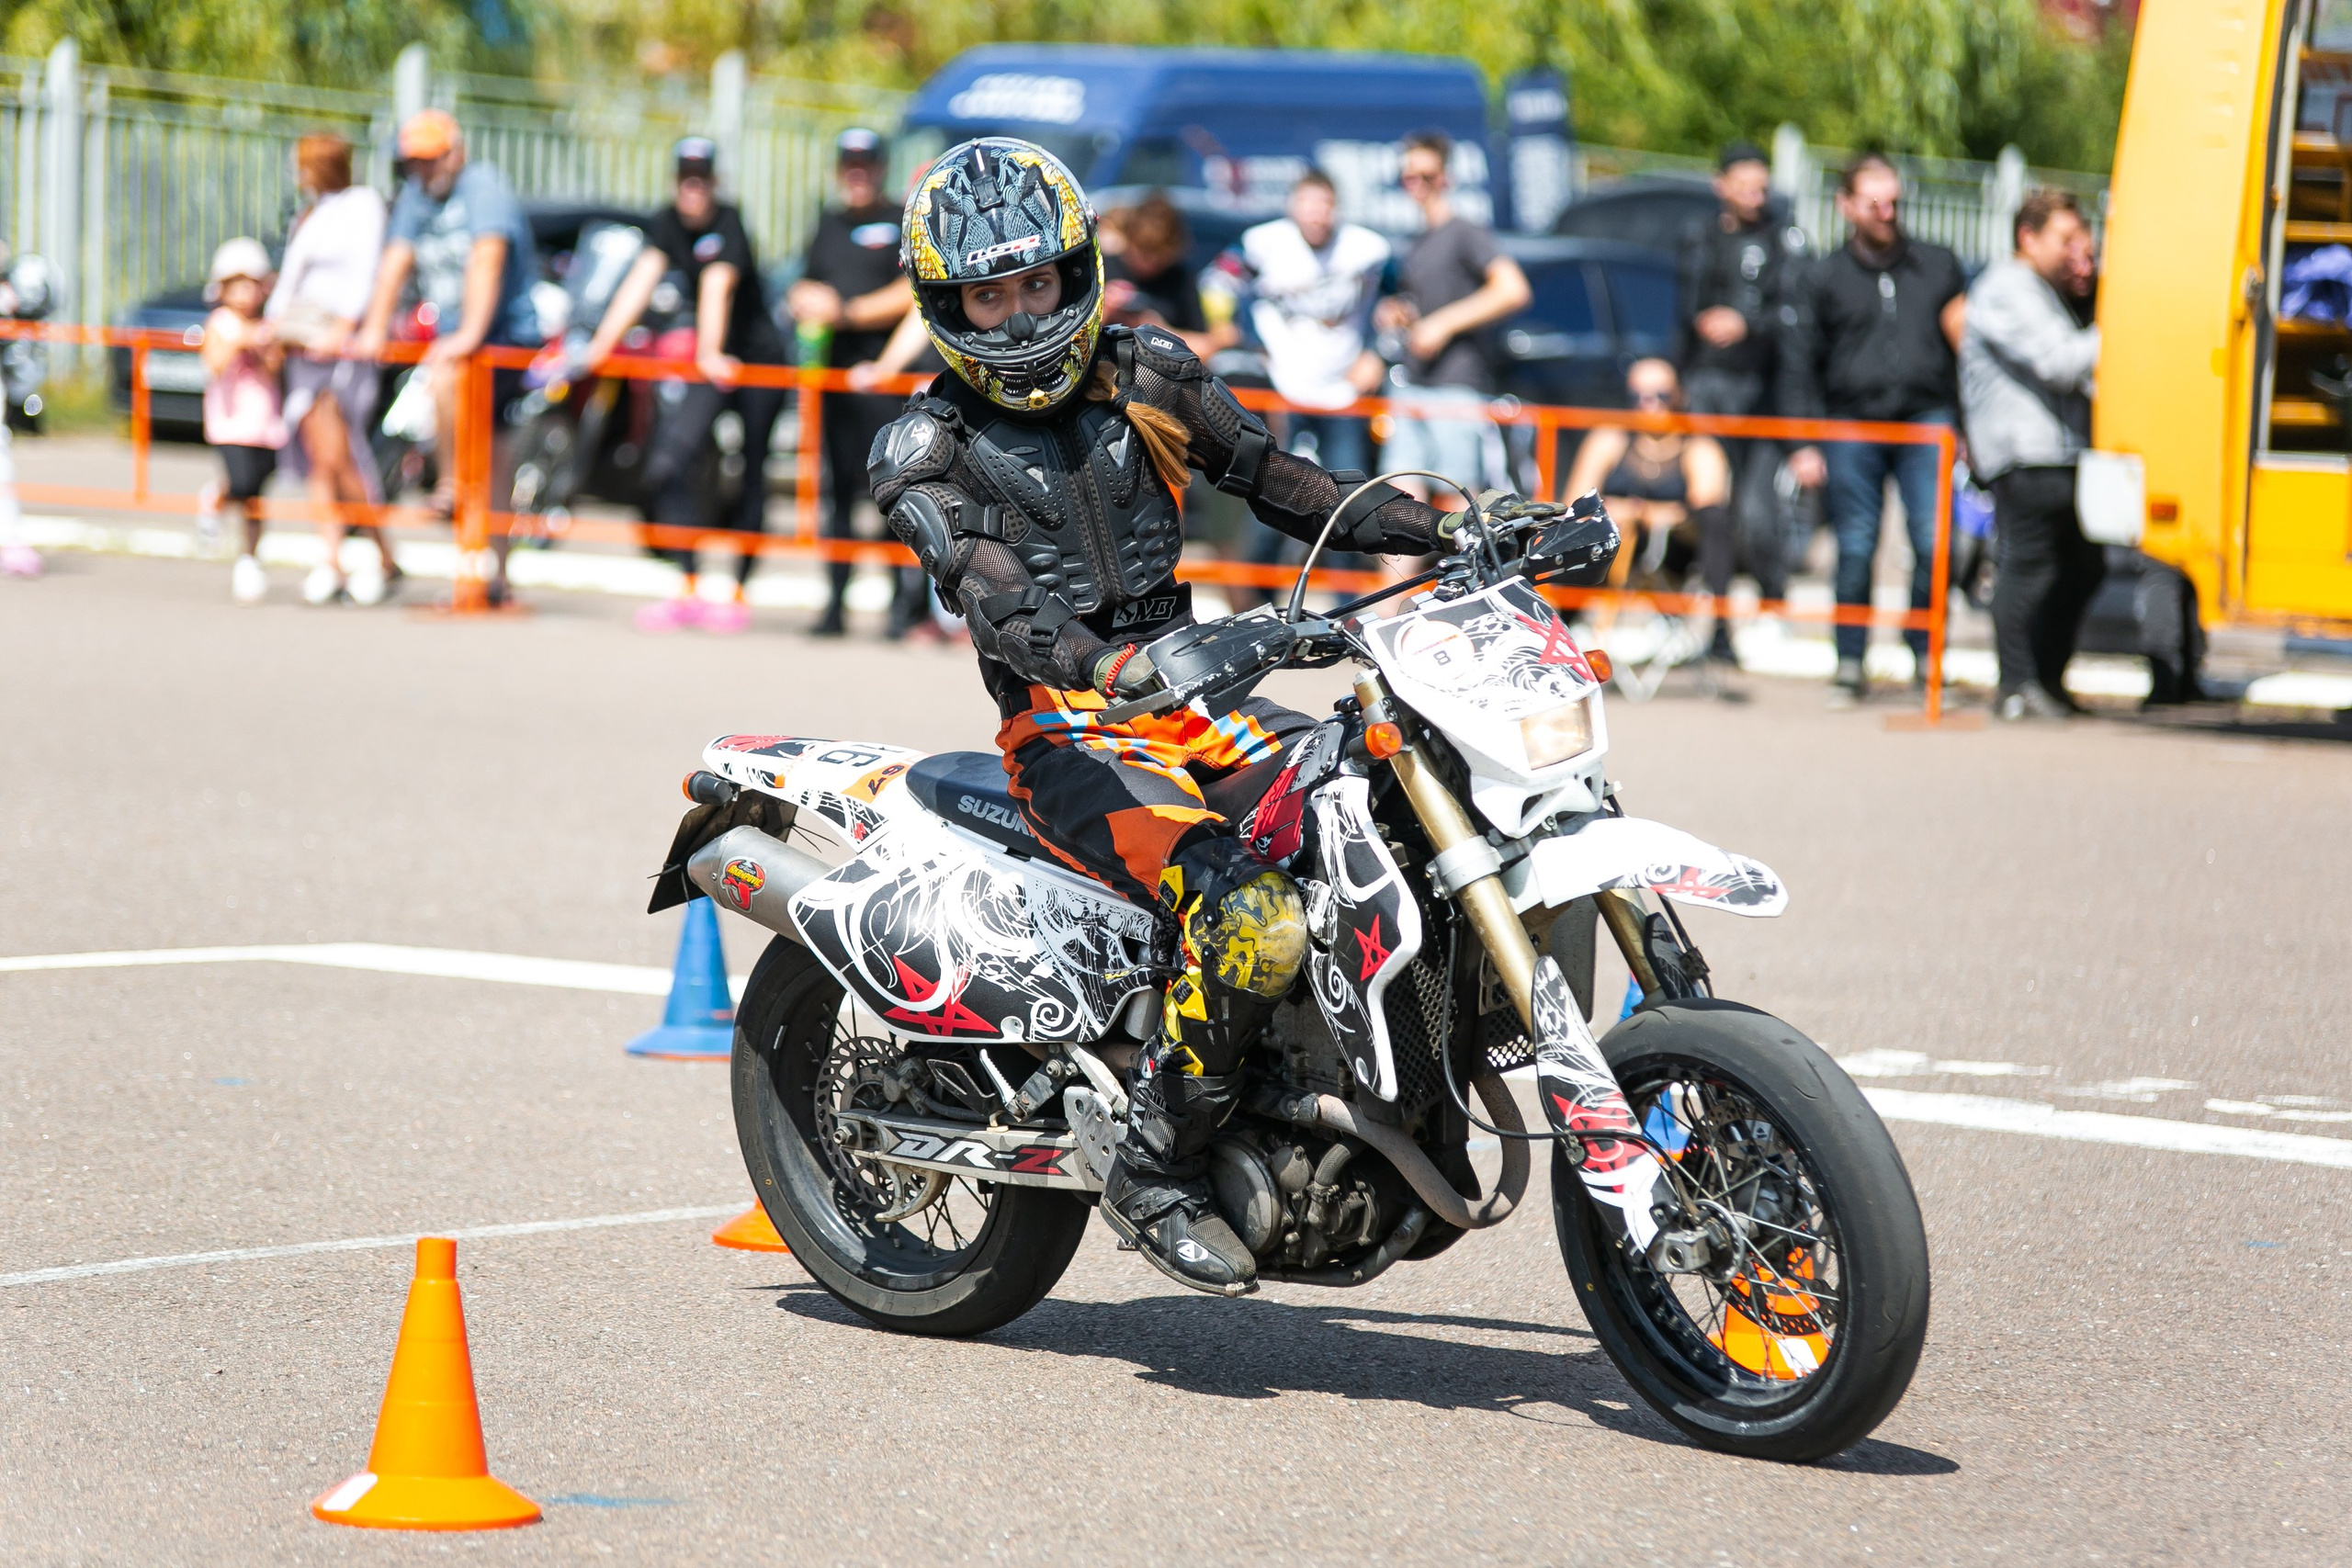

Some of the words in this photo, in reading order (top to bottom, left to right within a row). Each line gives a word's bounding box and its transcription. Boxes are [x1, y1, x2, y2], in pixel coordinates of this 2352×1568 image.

[967, 234, 1041, 265] LS2
[1433, 649, 1452, 666] 8
[957, 795, 1035, 838] SUZUK
[890, 1131, 1064, 1175] DR-Z
